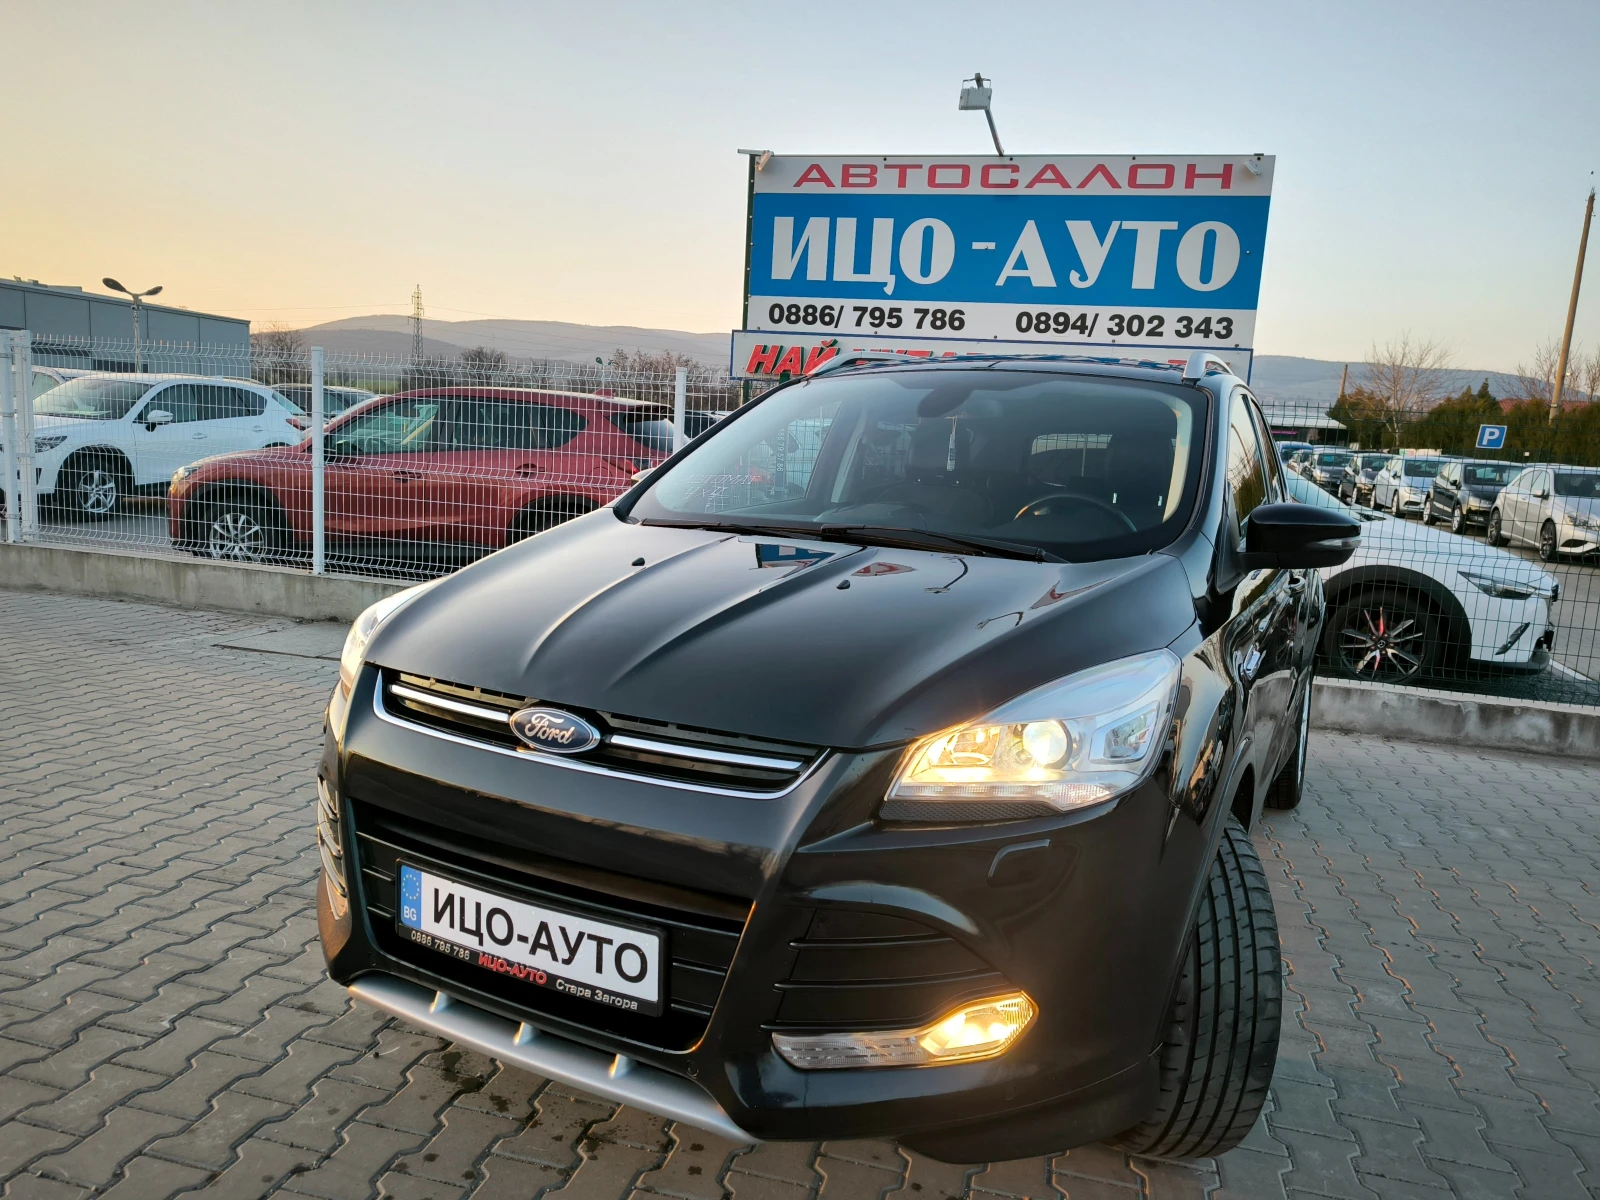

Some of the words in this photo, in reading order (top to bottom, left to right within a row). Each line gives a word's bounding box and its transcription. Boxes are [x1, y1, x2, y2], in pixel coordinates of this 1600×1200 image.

[792, 163, 1233, 190] АВТОСАЛОН
[768, 303, 844, 328] 0886/
[852, 306, 903, 328] 795
[913, 308, 966, 331] 786
[1015, 311, 1099, 337] 0894/
[1107, 314, 1165, 337] 302
[1174, 316, 1234, 339] 343
[1482, 428, 1499, 445] P
[524, 713, 576, 745] Ford
[403, 905, 417, 922] BG
[432, 888, 649, 984] ИЦО-АУТО
[411, 930, 432, 946] 0886
[434, 939, 451, 953] 795
[453, 946, 470, 960] 786
[478, 951, 548, 985] ИЦО-АУТО
[555, 979, 592, 998] Стара
[594, 989, 639, 1011] Загора
